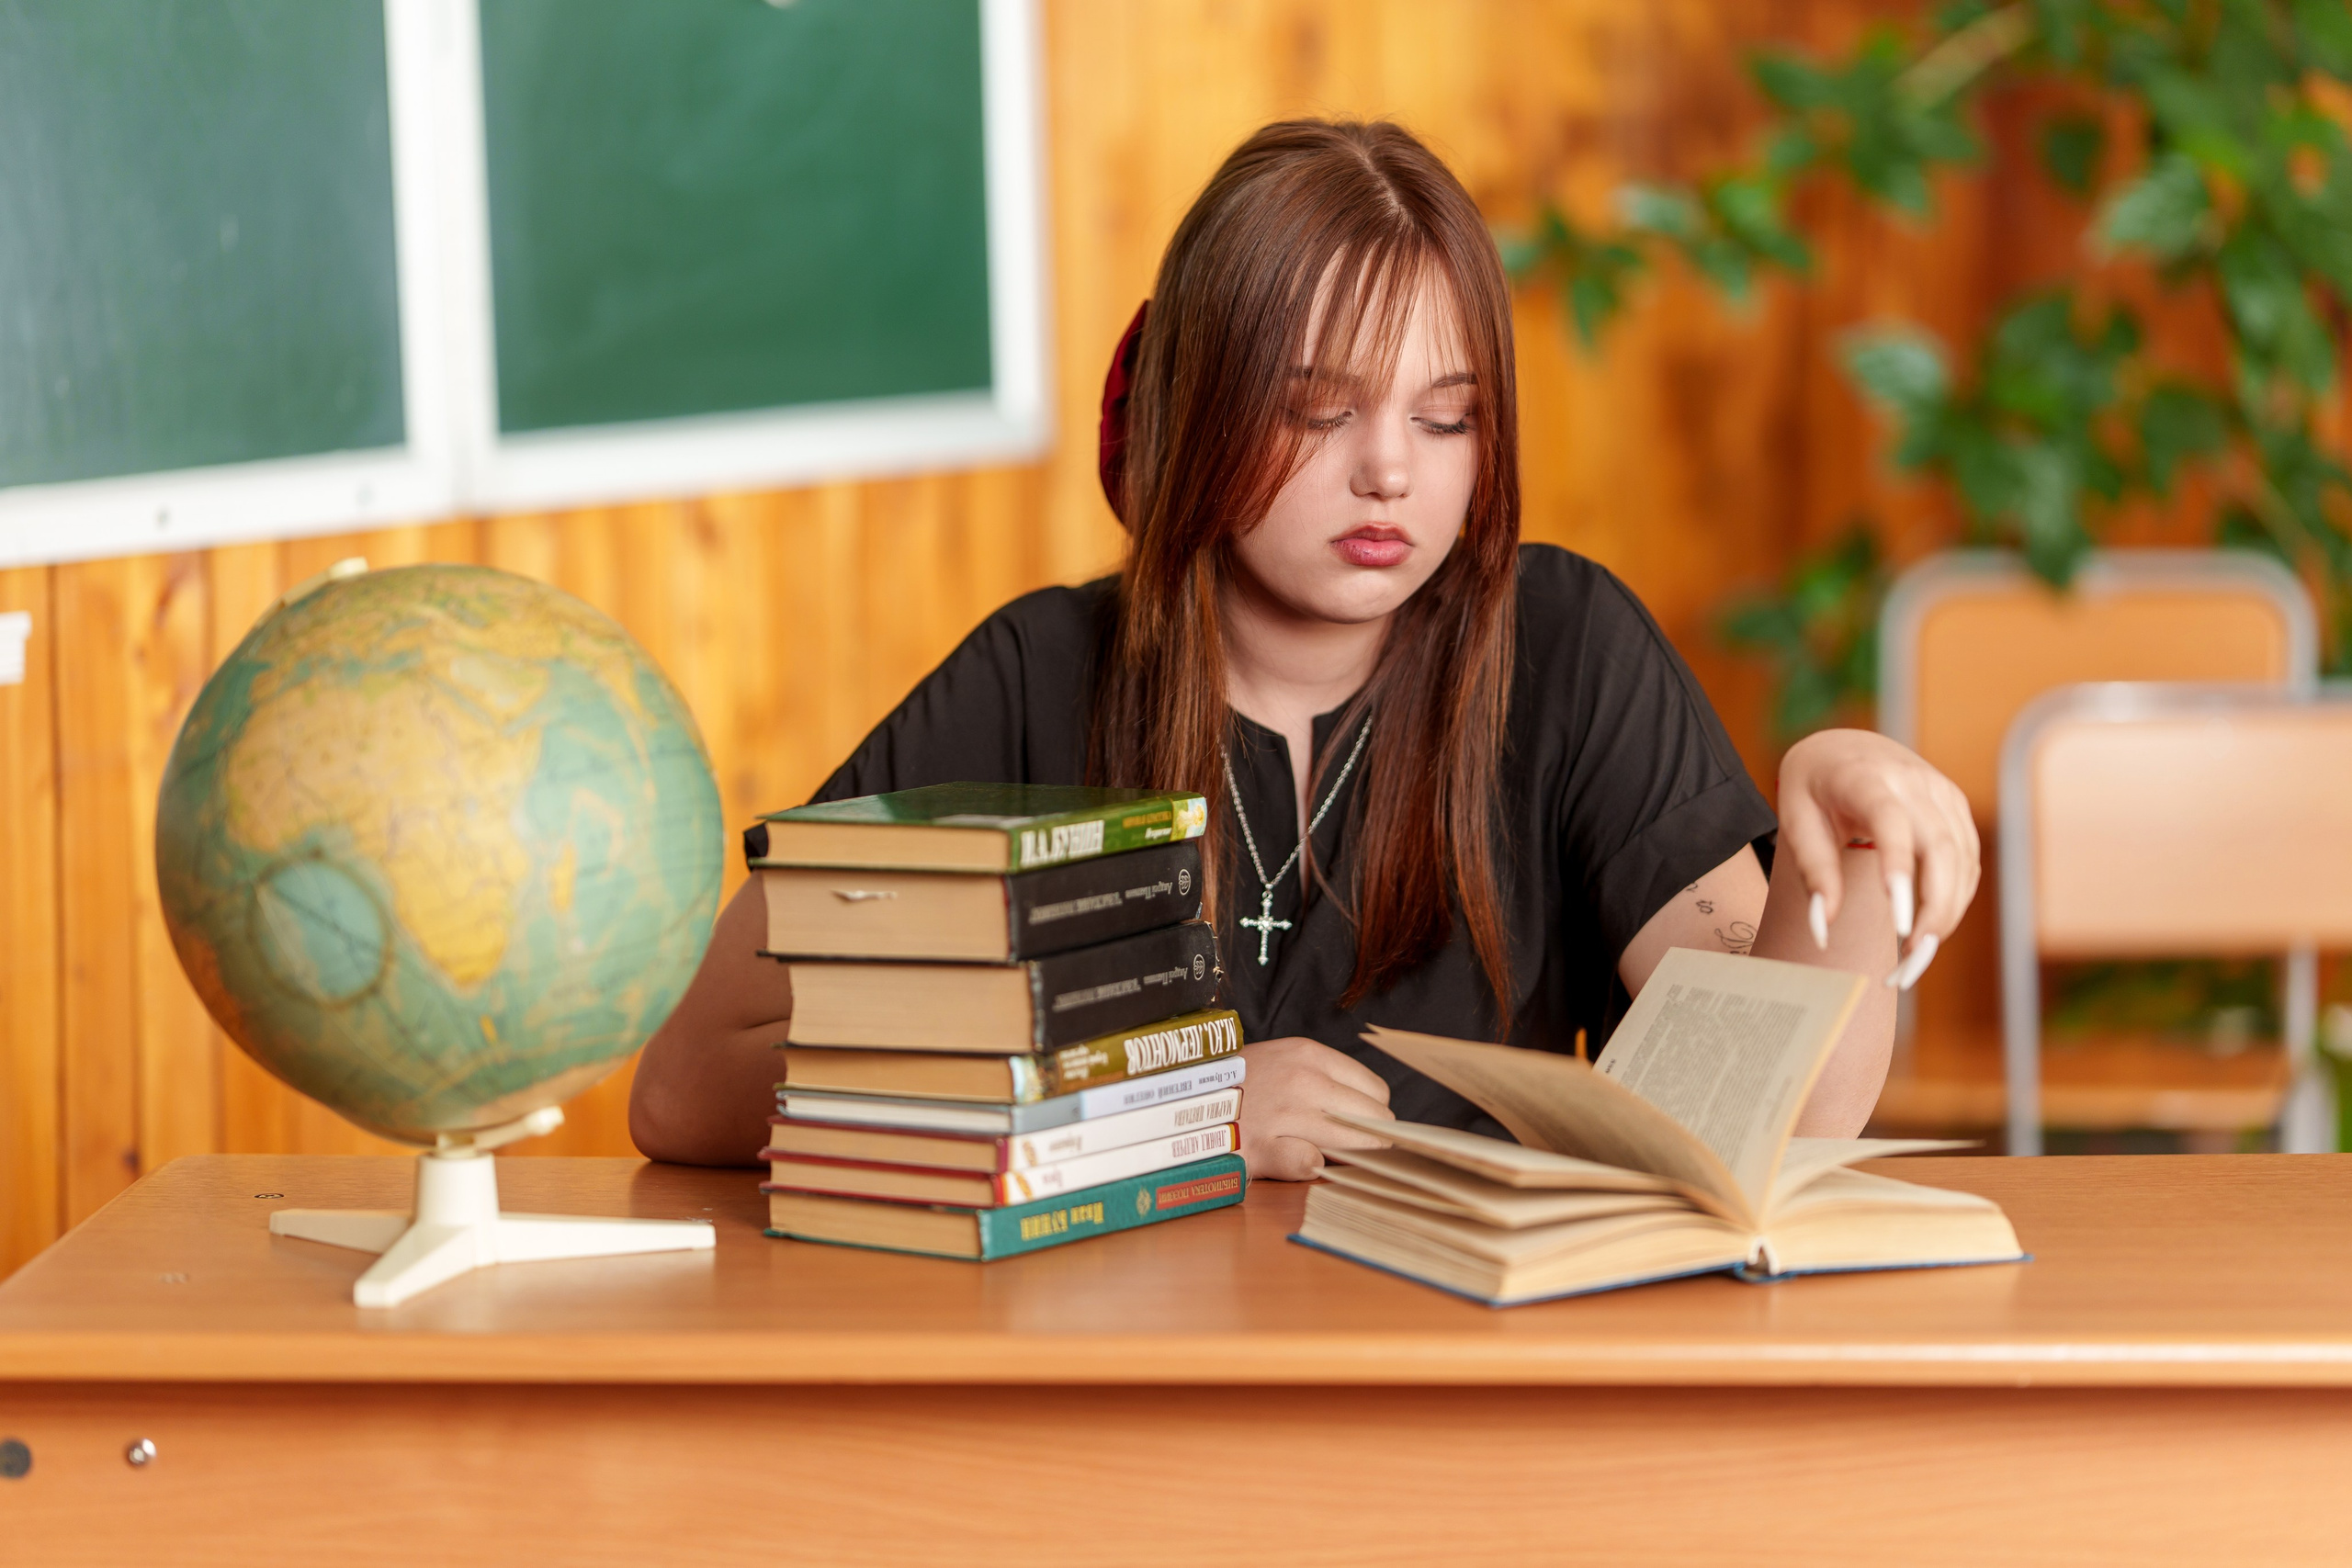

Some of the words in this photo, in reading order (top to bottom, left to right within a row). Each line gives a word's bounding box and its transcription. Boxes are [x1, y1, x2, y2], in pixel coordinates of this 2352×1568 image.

[1158, 1080, 1193, 1099] ЕВГЕНИЙ
[1205, 1100, 1233, 1119] МАРИНА
[1171, 1136, 1199, 1157] АНДРЕЕВ
[1201, 1130, 1227, 1151] ЛЕОНИД
[1159, 1188, 1189, 1203] ПОЭЗИИ
[1191, 1178, 1238, 1196] БИБЛИОТЕКА
